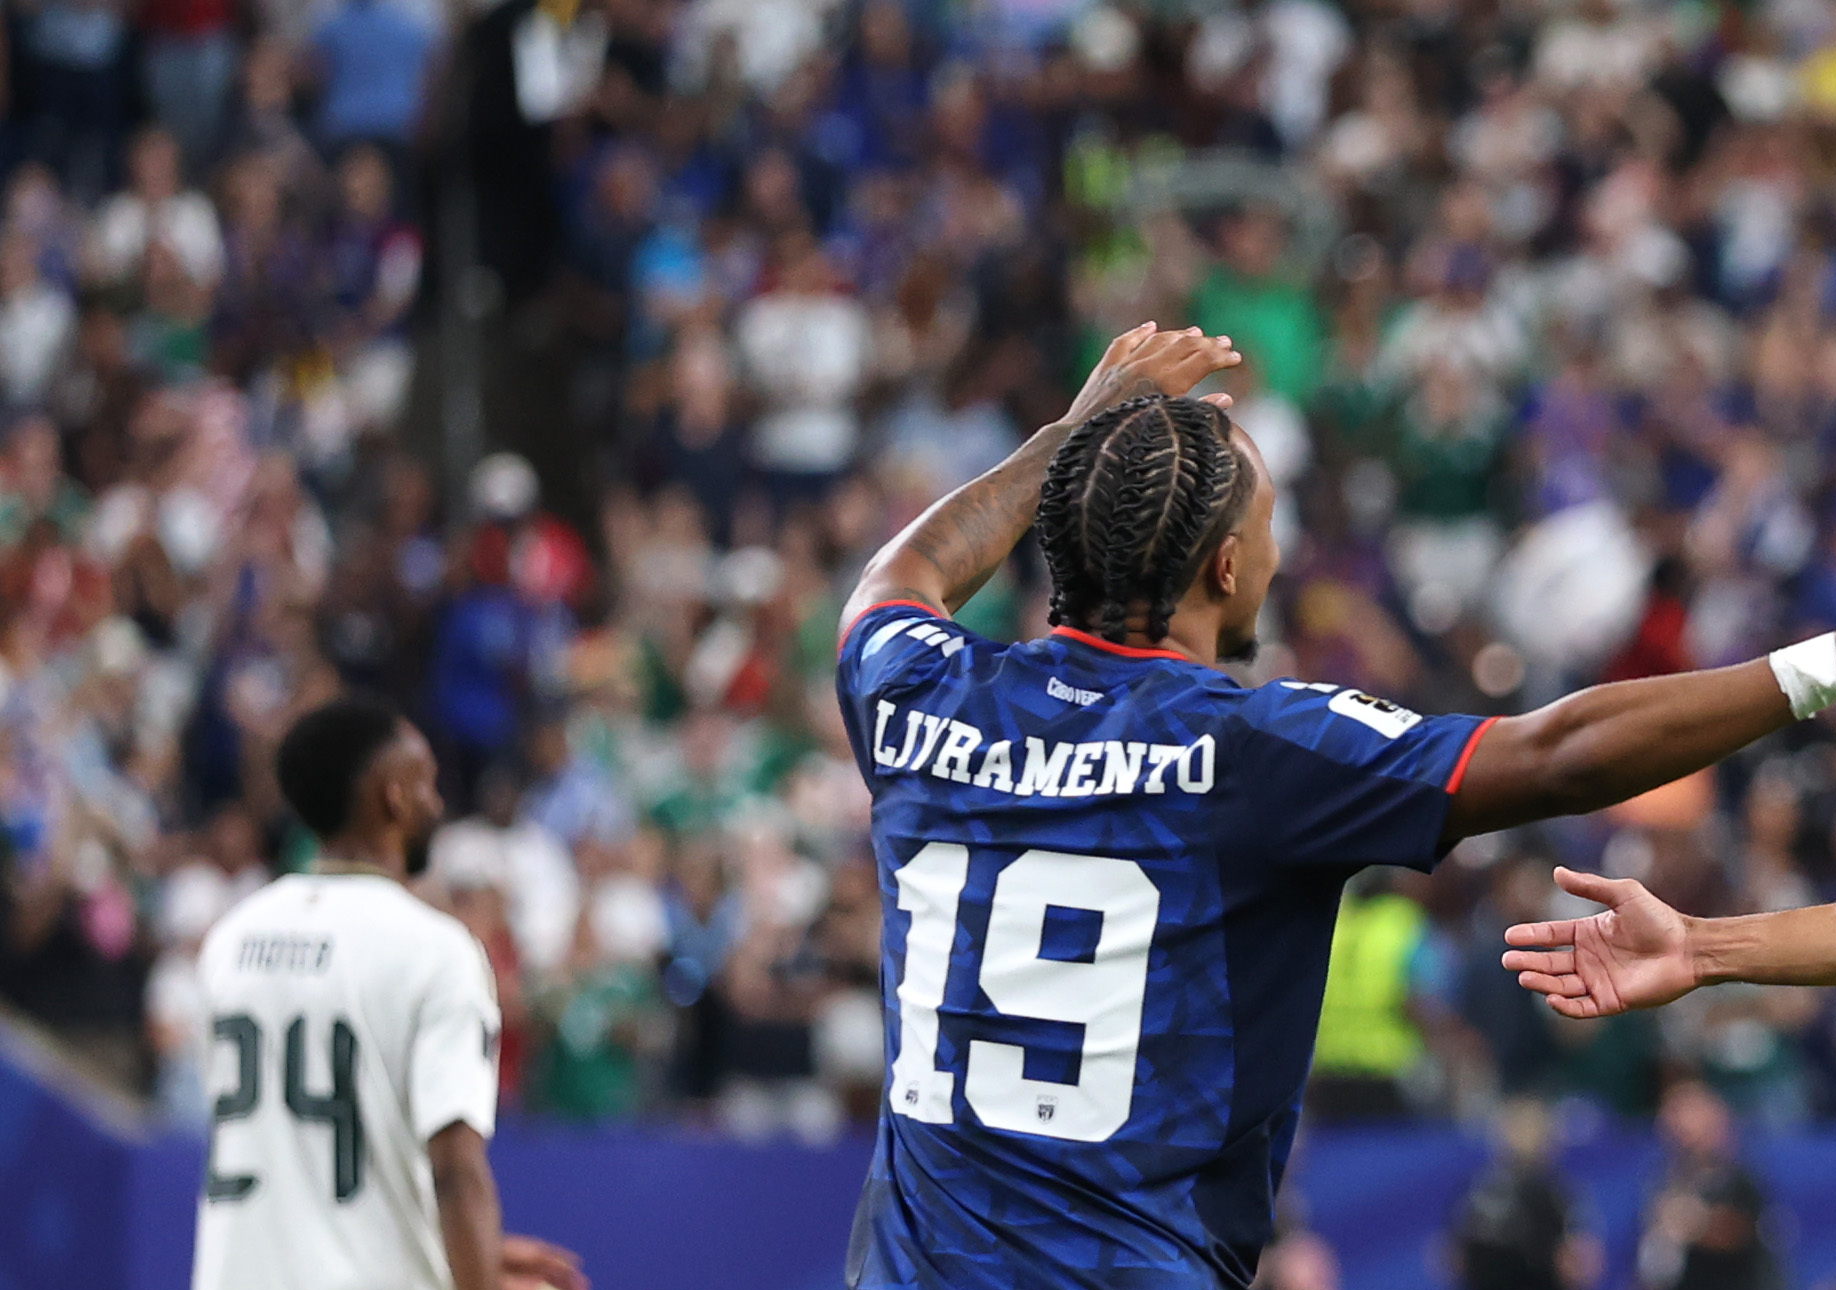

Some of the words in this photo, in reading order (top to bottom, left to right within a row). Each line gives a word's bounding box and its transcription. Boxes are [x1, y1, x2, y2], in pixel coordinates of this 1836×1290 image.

[873, 700, 1215, 797] LIVRAMENTO
[890, 841, 1160, 1142] 19
[207, 1013, 362, 1203] 24
